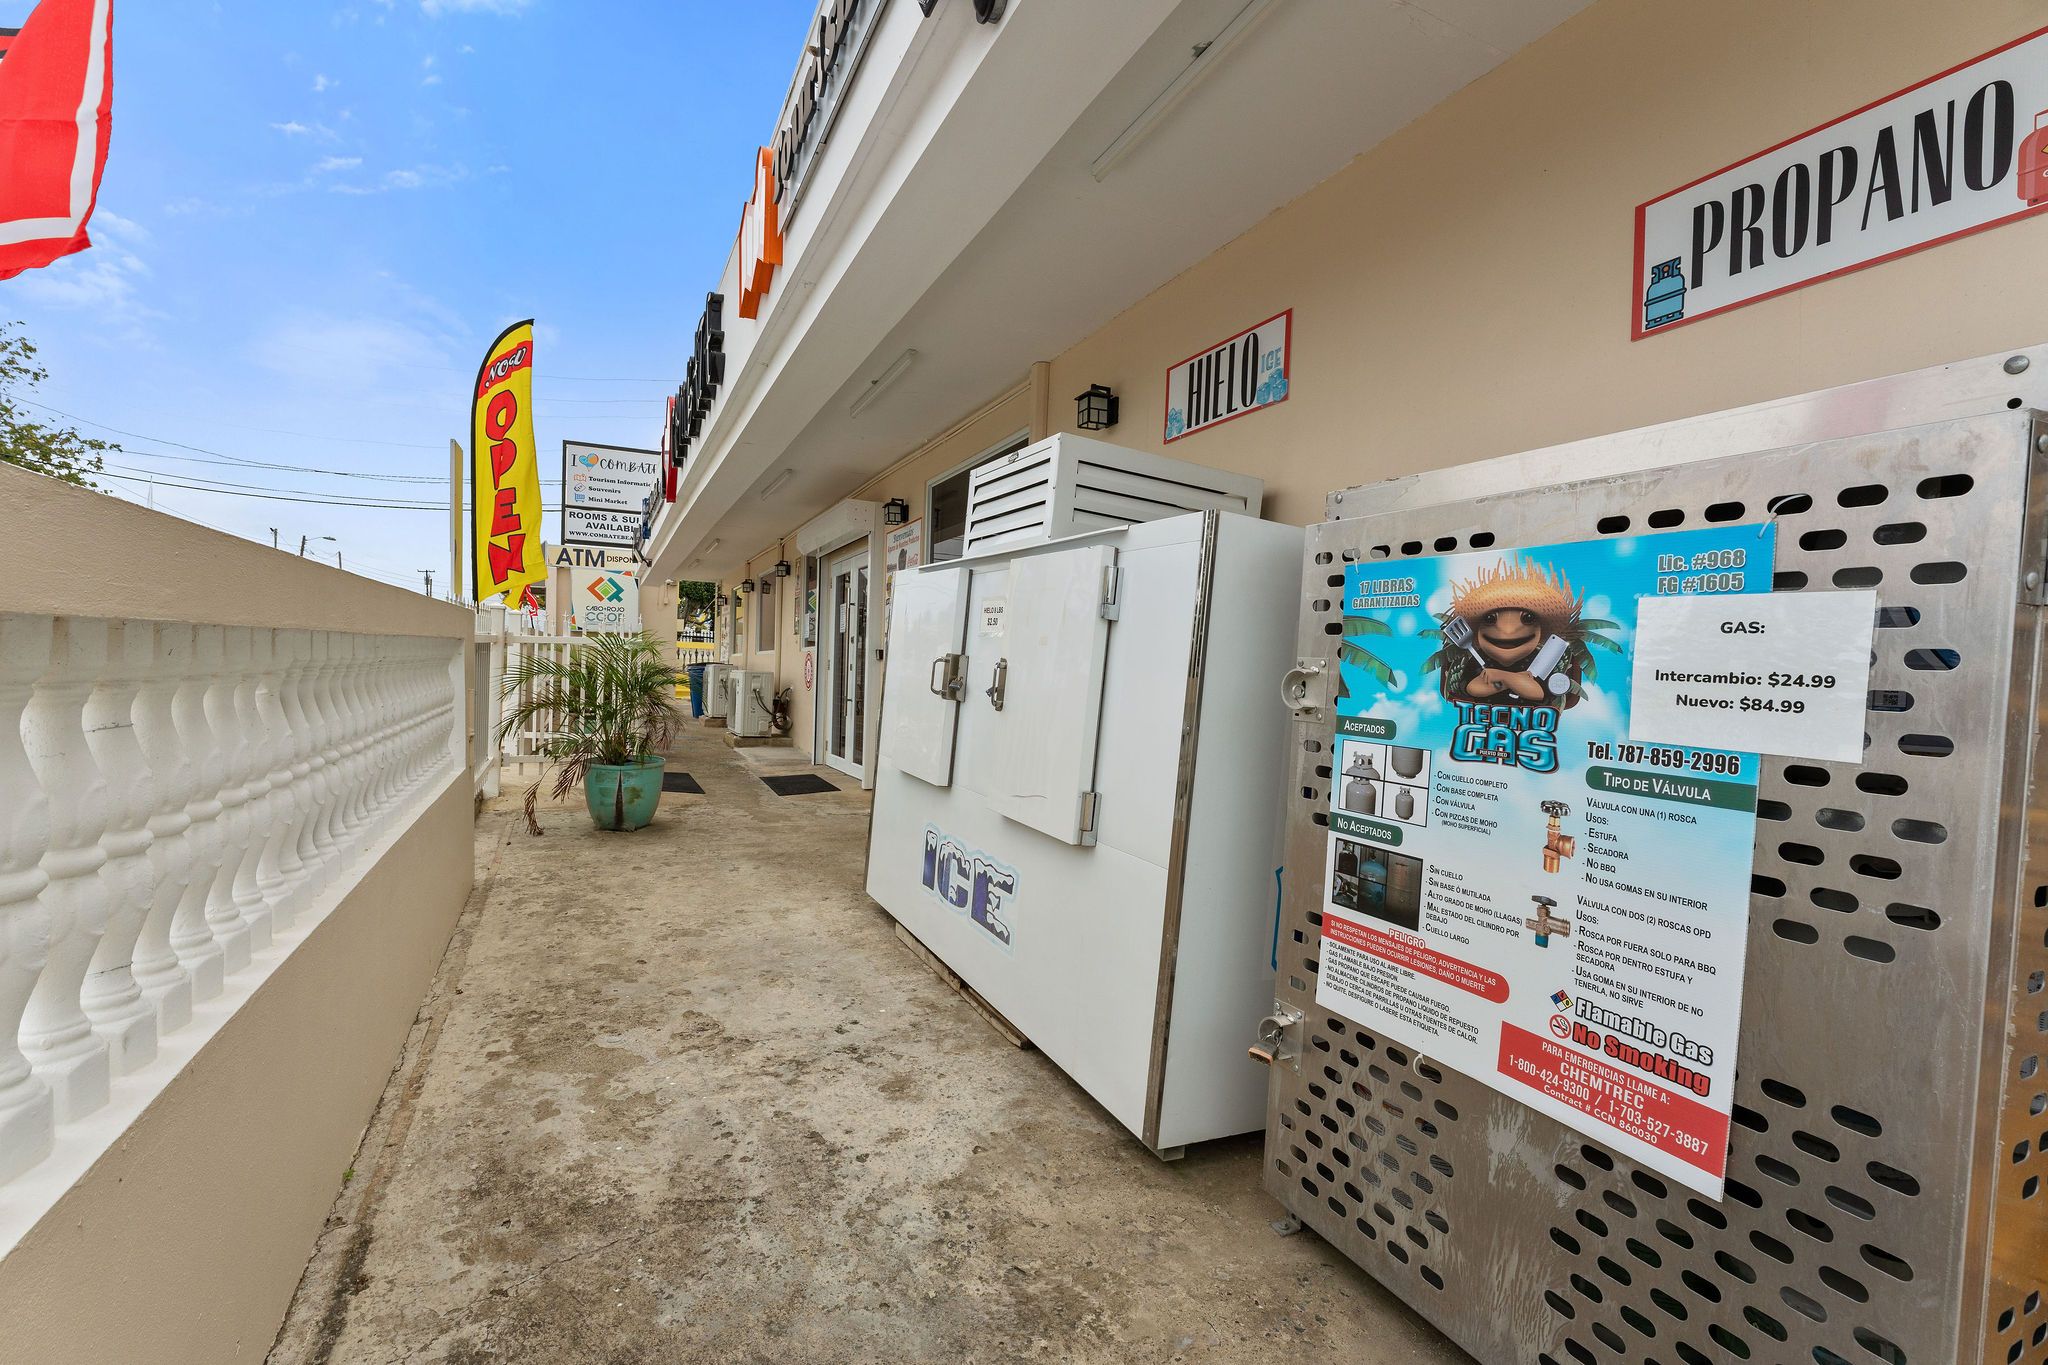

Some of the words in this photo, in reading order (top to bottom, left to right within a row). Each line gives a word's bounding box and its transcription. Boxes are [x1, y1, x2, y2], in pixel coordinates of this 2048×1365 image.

[1691, 79, 2014, 290] PROPANO
[1187, 333, 1258, 429] HIELO
[1261, 347, 1282, 373] ICE
[572, 454, 577, 466] I
[486, 389, 526, 585] OPEN
[588, 486, 620, 494] Souvenirs
[589, 476, 616, 484] Tourism
[569, 512, 608, 521] ROOMS
[556, 548, 605, 568] ATM
[1658, 554, 1688, 571] Lic.
[1692, 549, 1746, 569] #968
[1360, 581, 1371, 594] 17
[1372, 578, 1414, 594] LIBRAS
[1658, 576, 1679, 594] FG
[1682, 572, 1744, 592] #1605
[1352, 594, 1420, 608] GARANTIZADAS
[1720, 622, 1765, 634] GAS:
[1655, 670, 1762, 686] Intercambio:
[1768, 672, 1836, 688] $24.99
[1676, 694, 1734, 709] Nuevo:
[1739, 696, 1805, 713] $84.99
[1344, 720, 1385, 734] ACEPTADOS
[1454, 700, 1558, 732] TECNO
[1450, 723, 1559, 774] GAS
[1588, 742, 1613, 760] Tel.
[1617, 744, 1740, 776] 787-859-2996
[1451, 774, 1474, 784] CUELLO
[1475, 778, 1508, 790] COMPLETO
[1603, 772, 1630, 789] TIPO
[1634, 779, 1649, 792] DE
[1652, 778, 1711, 800] VÁLVULA
[1450, 787, 1466, 796] BASE
[1467, 790, 1498, 802] COMPLETA
[1449, 813, 1469, 823] PIZCAS
[1470, 817, 1478, 825] DE
[1479, 819, 1498, 828] MOHO
[1621, 805, 1637, 814] CON
[1639, 808, 1656, 818] UNA
[1656, 811, 1666, 821] (1)
[1668, 812, 1697, 824] ROSCA
[1337, 817, 1348, 830] NO
[1349, 820, 1392, 840] ACEPTADOS
[1442, 820, 1458, 828] (MOHO
[1458, 823, 1491, 836] SUPERFICIAL)
[1440, 870, 1463, 881] CUELLO
[1600, 863, 1616, 873] BBQ
[922, 830, 1014, 946] ICE
[1440, 882, 1455, 892] BASE
[1462, 888, 1491, 902] MUTILADA
[1599, 878, 1614, 888] USA
[1615, 882, 1642, 895] GOMAS
[1644, 889, 1655, 898] EN
[1657, 892, 1668, 901] SU
[1669, 895, 1708, 911] INTERIOR
[1426, 912, 1448, 925] DEBAJO
[1444, 896, 1464, 908] GRADO
[1465, 902, 1473, 910] DE
[1474, 905, 1493, 916] MOHO
[1494, 911, 1522, 926] (LLAGAS)
[1441, 908, 1463, 920] ESTADO
[1464, 915, 1476, 925] DEL
[1476, 919, 1505, 933] CILINDRO
[1506, 928, 1520, 938] POR
[1611, 906, 1627, 917] CON
[1629, 911, 1645, 922] DOS
[1646, 916, 1656, 926] (2)
[1658, 918, 1691, 934] ROSCAS
[1693, 928, 1711, 939] OPD
[1389, 929, 1426, 949] PELIGRO
[1449, 933, 1470, 945] LARGO
[1329, 941, 1356, 957] SOLAMENTE
[1356, 952, 1369, 961] PARA
[1370, 957, 1380, 966] USO
[1380, 961, 1386, 969] AL
[1387, 964, 1399, 974] AIRE
[1400, 968, 1415, 980] LIBRE.
[1576, 953, 1615, 972] SECADORA
[1606, 936, 1622, 947] POR
[1623, 941, 1648, 955] FUERA
[1650, 948, 1672, 962] SOLO
[1674, 955, 1696, 969] PARA
[1697, 962, 1716, 975] BBQ
[1605, 951, 1621, 962] POR
[1622, 956, 1653, 972] DENTRO
[1654, 966, 1685, 983] ESTUFA
[1687, 976, 1693, 984] Y
[1574, 978, 1608, 997] TENERLA,
[1609, 990, 1620, 1000] NO
[1621, 994, 1644, 1008] SIRVE
[1593, 974, 1614, 987] GOMA
[1616, 981, 1626, 991] EN
[1627, 985, 1638, 995] SU
[1640, 989, 1676, 1008] INTERIOR
[1678, 1002, 1689, 1012] DE
[1691, 1006, 1704, 1017] NO
[1575, 996, 1667, 1048] Flamable
[1669, 1032, 1714, 1066] Gas
[1572, 1022, 1601, 1050] No
[1604, 1034, 1711, 1097] Smoking
[1542, 1042, 1562, 1058] PARA
[1565, 1051, 1625, 1085] EMERGENCIAS
[1627, 1078, 1658, 1100] LLAME
[1660, 1092, 1670, 1104] A:
[1560, 1062, 1644, 1109] CHEMTREC
[1510, 1054, 1590, 1100] 1-800-424-9300
[1595, 1095, 1602, 1105] /
[1610, 1100, 1708, 1155] 1-703-527-3887
[1544, 1084, 1582, 1108] Contract
[1586, 1104, 1591, 1112] #
[1594, 1108, 1616, 1124] CCN
[1619, 1120, 1657, 1144] 860030
